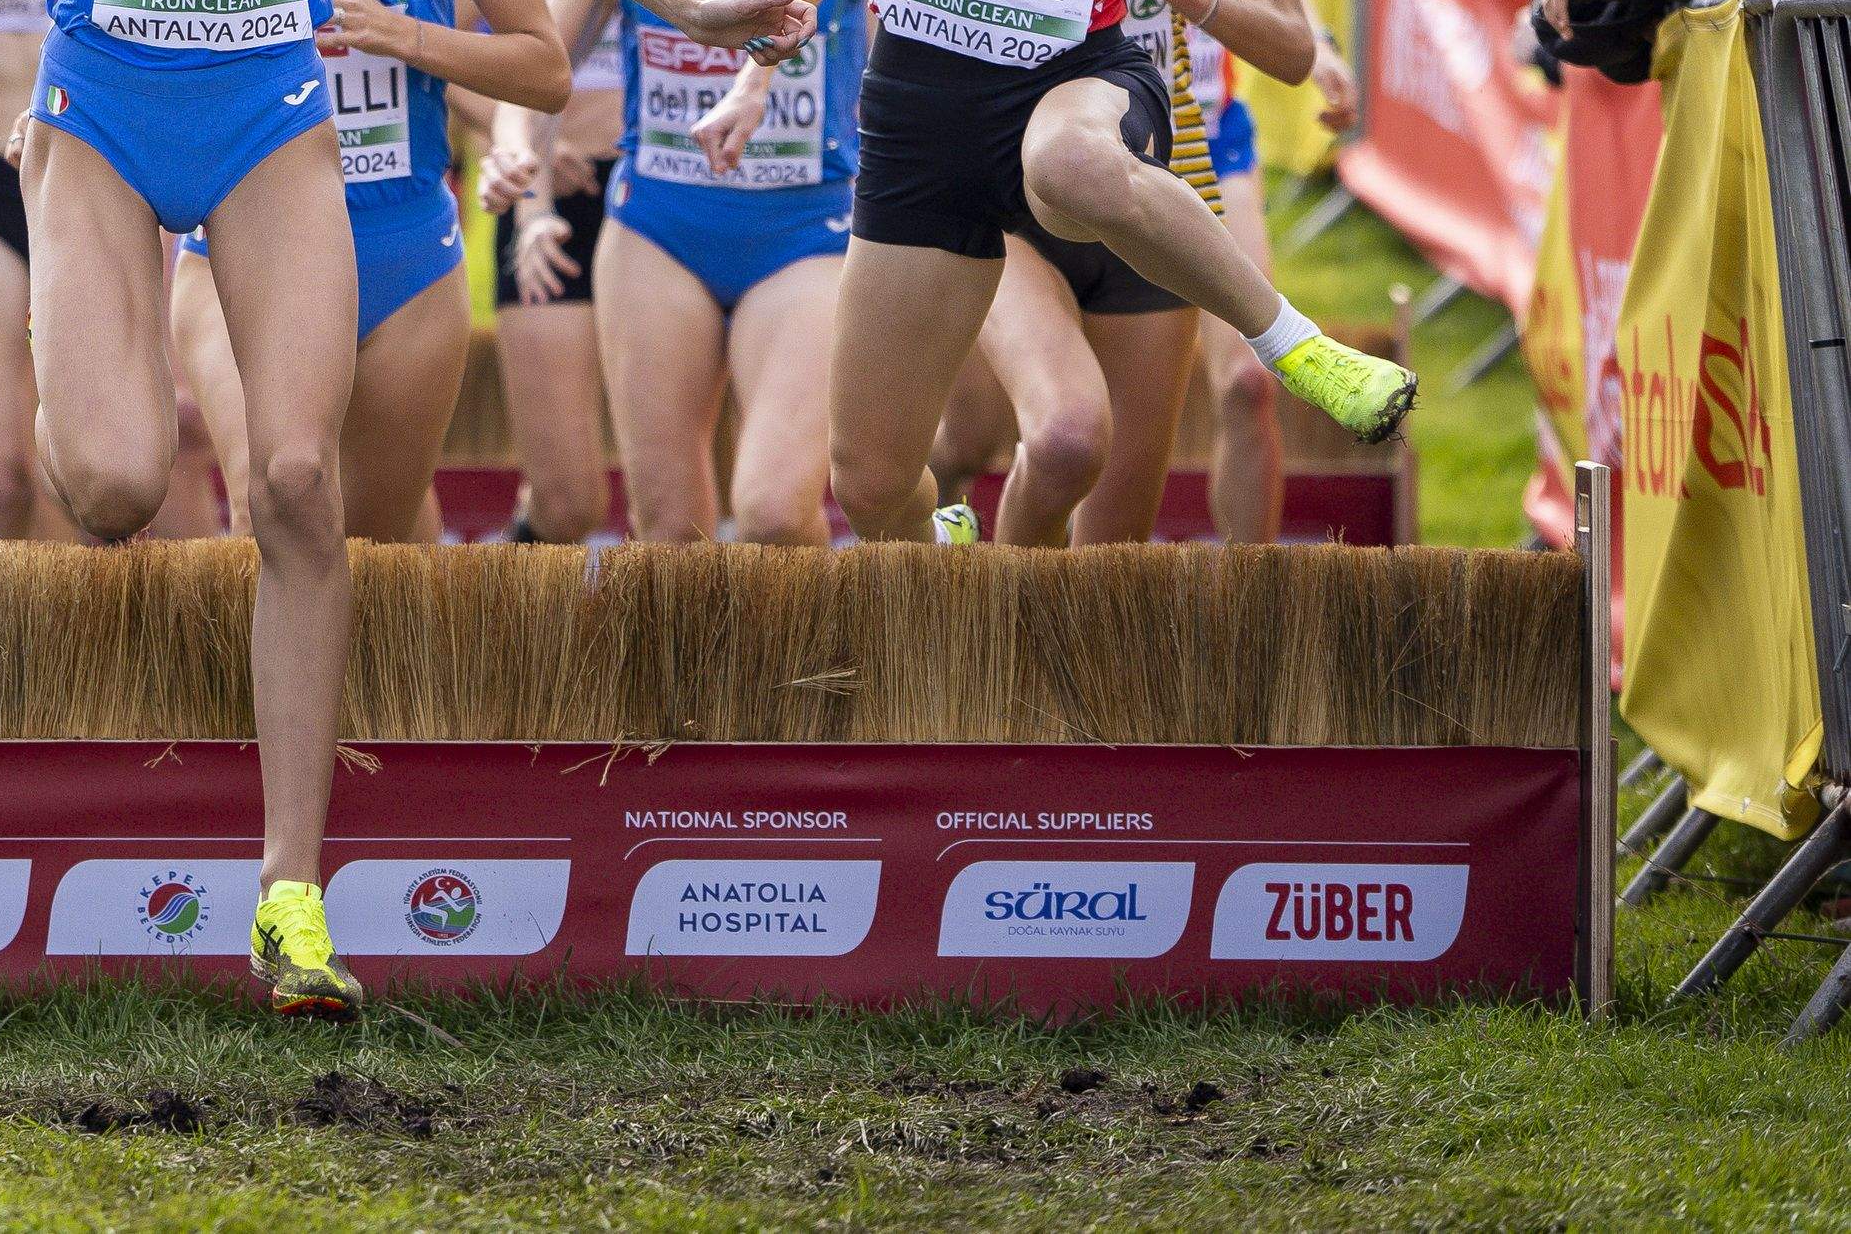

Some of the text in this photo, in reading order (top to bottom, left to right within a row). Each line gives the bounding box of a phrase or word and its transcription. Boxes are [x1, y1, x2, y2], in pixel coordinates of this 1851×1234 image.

[107, 11, 300, 44] ANTALYA 2024
[883, 3, 994, 55] ANTALYA
[341, 150, 398, 176] 2024
[625, 811, 848, 829] NATIONAL SPONSOR
[936, 812, 1154, 830] OFFICIAL SUPPLIERS
[139, 871, 208, 898] KEPEZ
[680, 882, 827, 903] ANATOLIA
[679, 912, 827, 934] HOSPITAL
[1265, 883, 1415, 941] ZÜBER
[1008, 924, 1126, 936] DOĞAL KAYNAK SUYU
